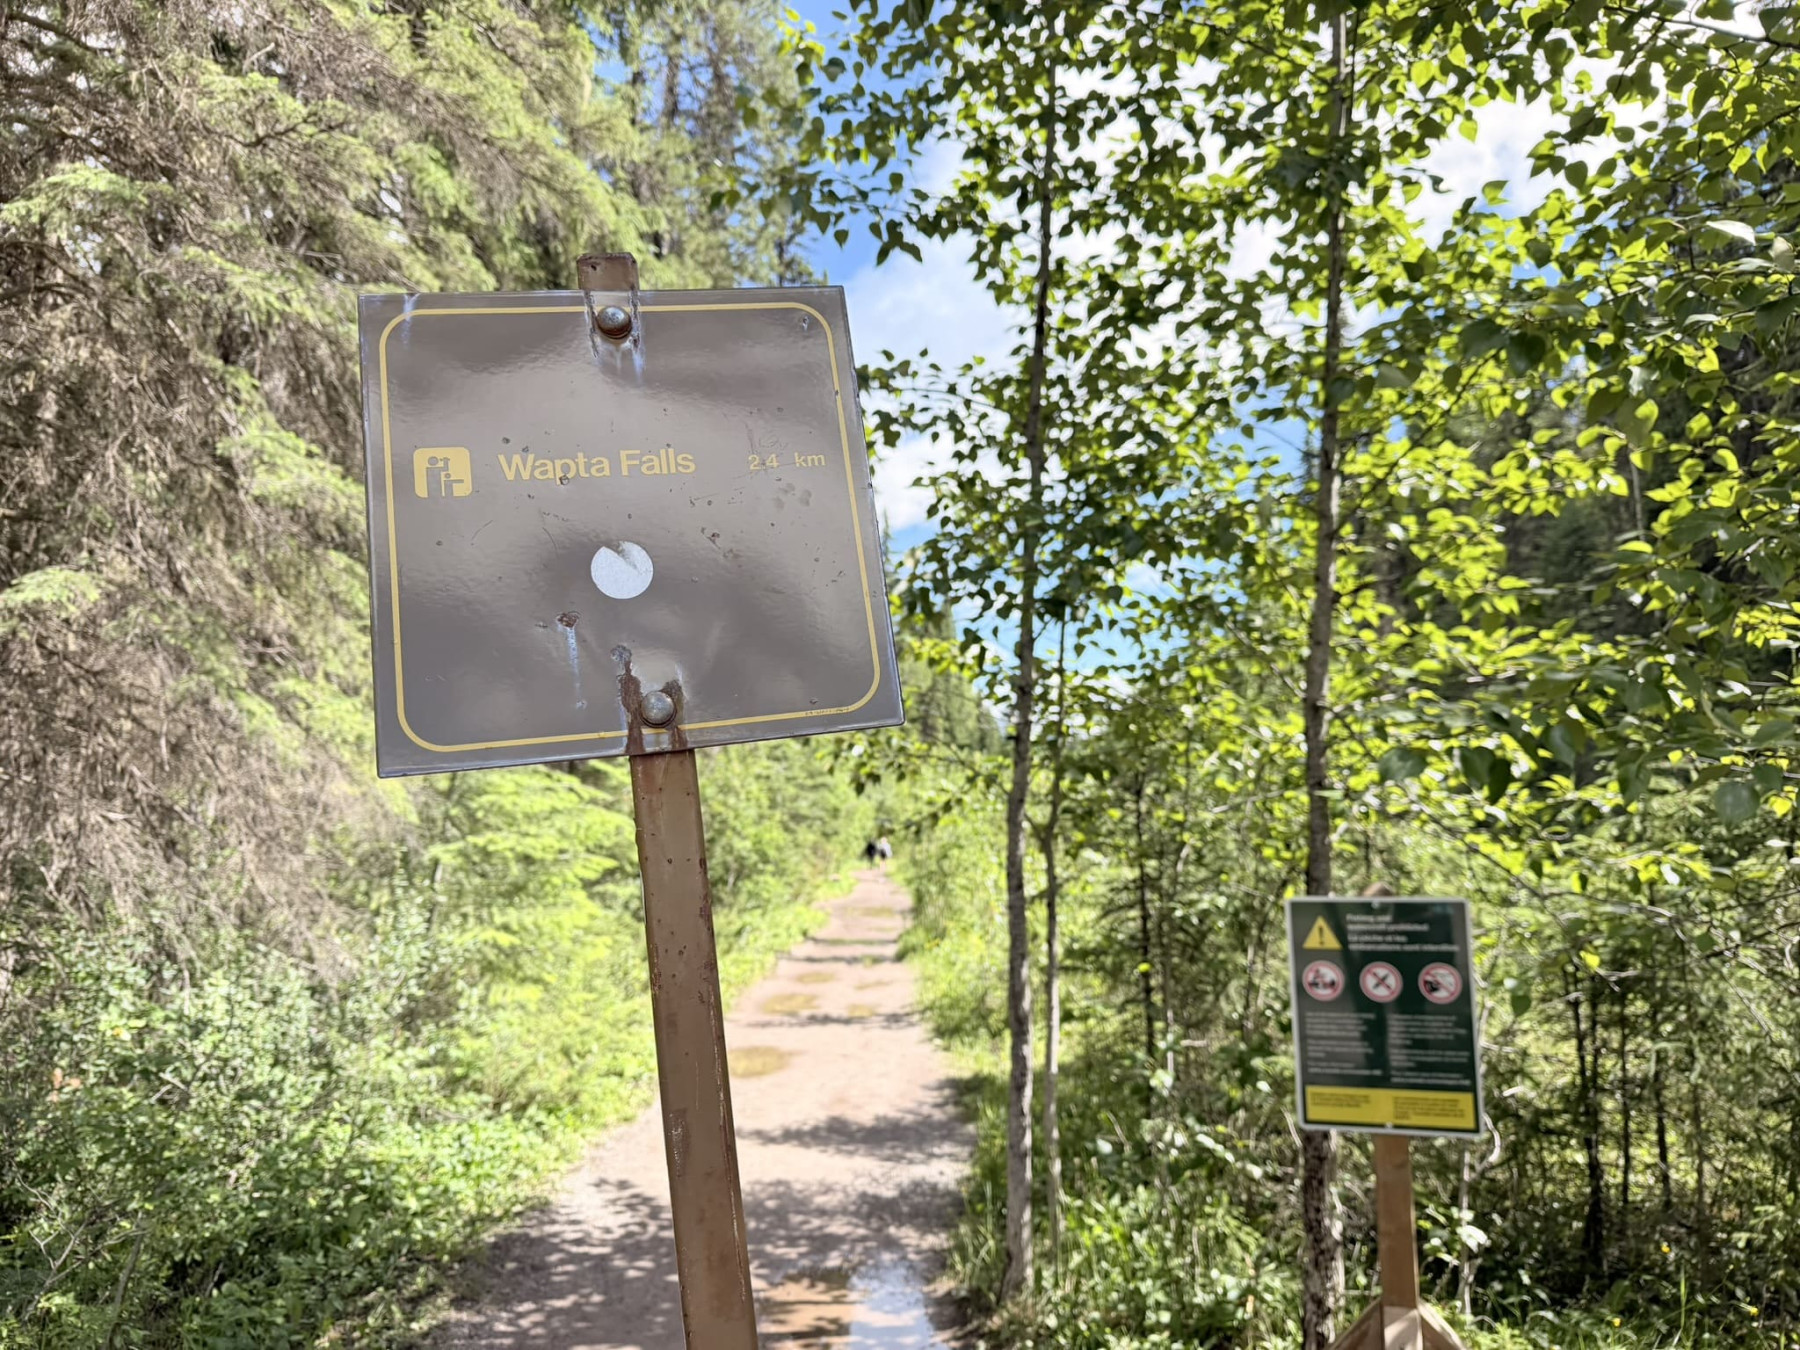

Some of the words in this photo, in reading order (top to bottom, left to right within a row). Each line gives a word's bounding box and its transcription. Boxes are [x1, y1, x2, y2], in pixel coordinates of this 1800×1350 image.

[497, 452, 610, 486] Wapta
[619, 448, 697, 476] Falls
[794, 451, 826, 468] km
